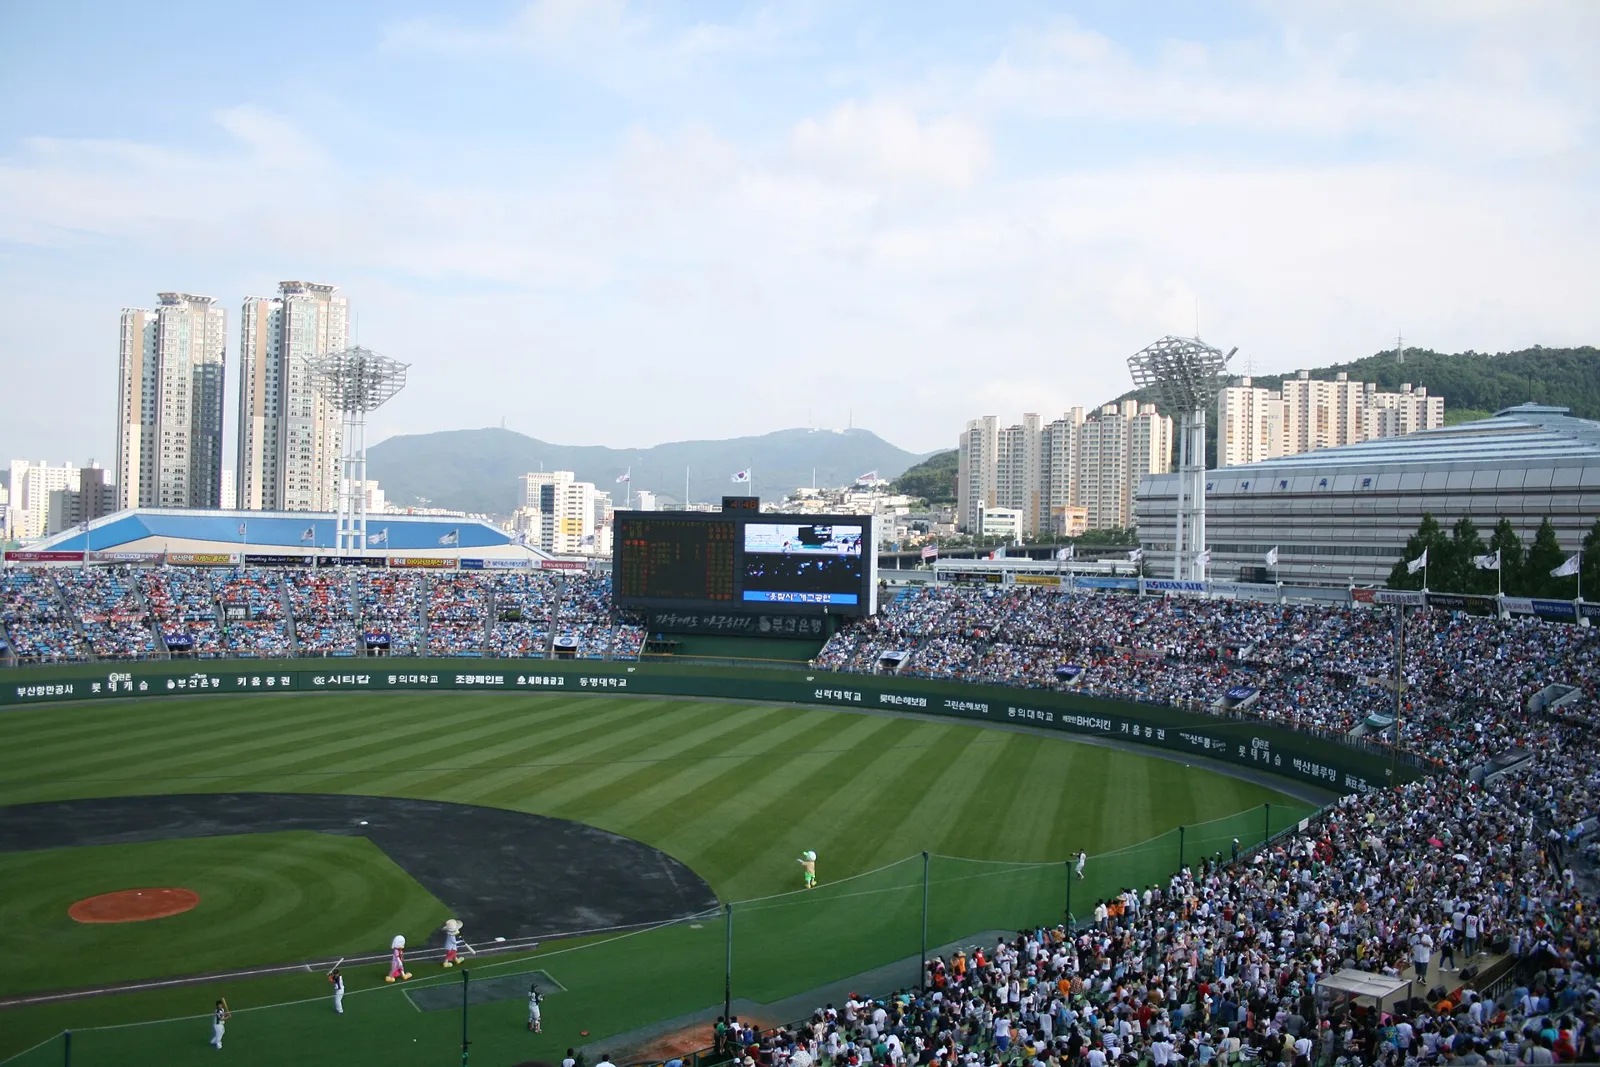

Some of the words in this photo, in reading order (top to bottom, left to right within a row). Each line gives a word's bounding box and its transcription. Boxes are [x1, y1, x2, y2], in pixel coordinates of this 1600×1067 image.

[1146, 581, 1182, 591] KOREAN
[1184, 582, 1204, 592] AIR
[655, 613, 700, 628] 가을에도
[772, 617, 822, 633] 부산은행
[178, 678, 220, 689] 부산은행
[237, 676, 291, 687] 키움증권
[388, 675, 439, 685] 동의대학교
[455, 675, 505, 685] 조광페인트
[528, 676, 565, 686] 새마을금고
[580, 677, 627, 688] 동명대학교
[17, 684, 74, 697] 부산항만공사
[92, 681, 149, 693] 롯데캐슬
[814, 689, 862, 701] 신라대학교
[880, 694, 927, 707] 롯데손해보험
[944, 699, 989, 713] 그린손해보험
[1008, 707, 1053, 722] 동의대학교
[1121, 723, 1165, 740] 키움증권
[1238, 745, 1281, 767] 롯데캐슬
[1293, 758, 1336, 782] 벽산블루밍
